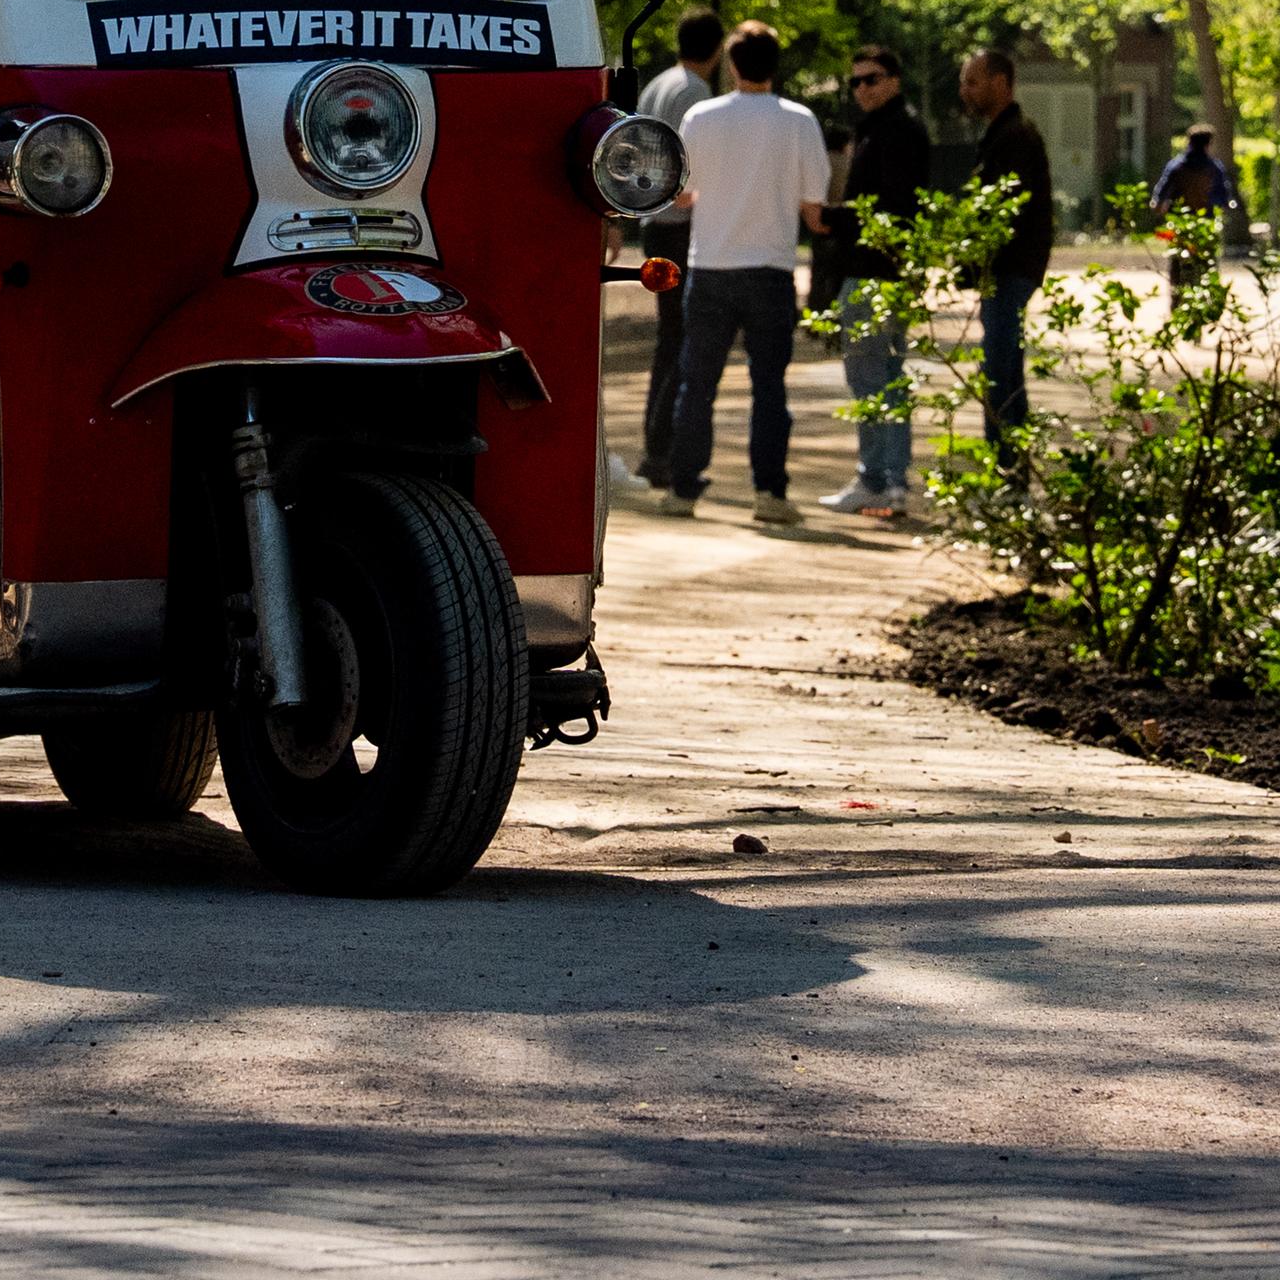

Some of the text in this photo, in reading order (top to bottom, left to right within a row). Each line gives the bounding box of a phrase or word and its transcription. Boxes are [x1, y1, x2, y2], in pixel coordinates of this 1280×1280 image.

[101, 10, 541, 56] WHATEVER IT TAKES
